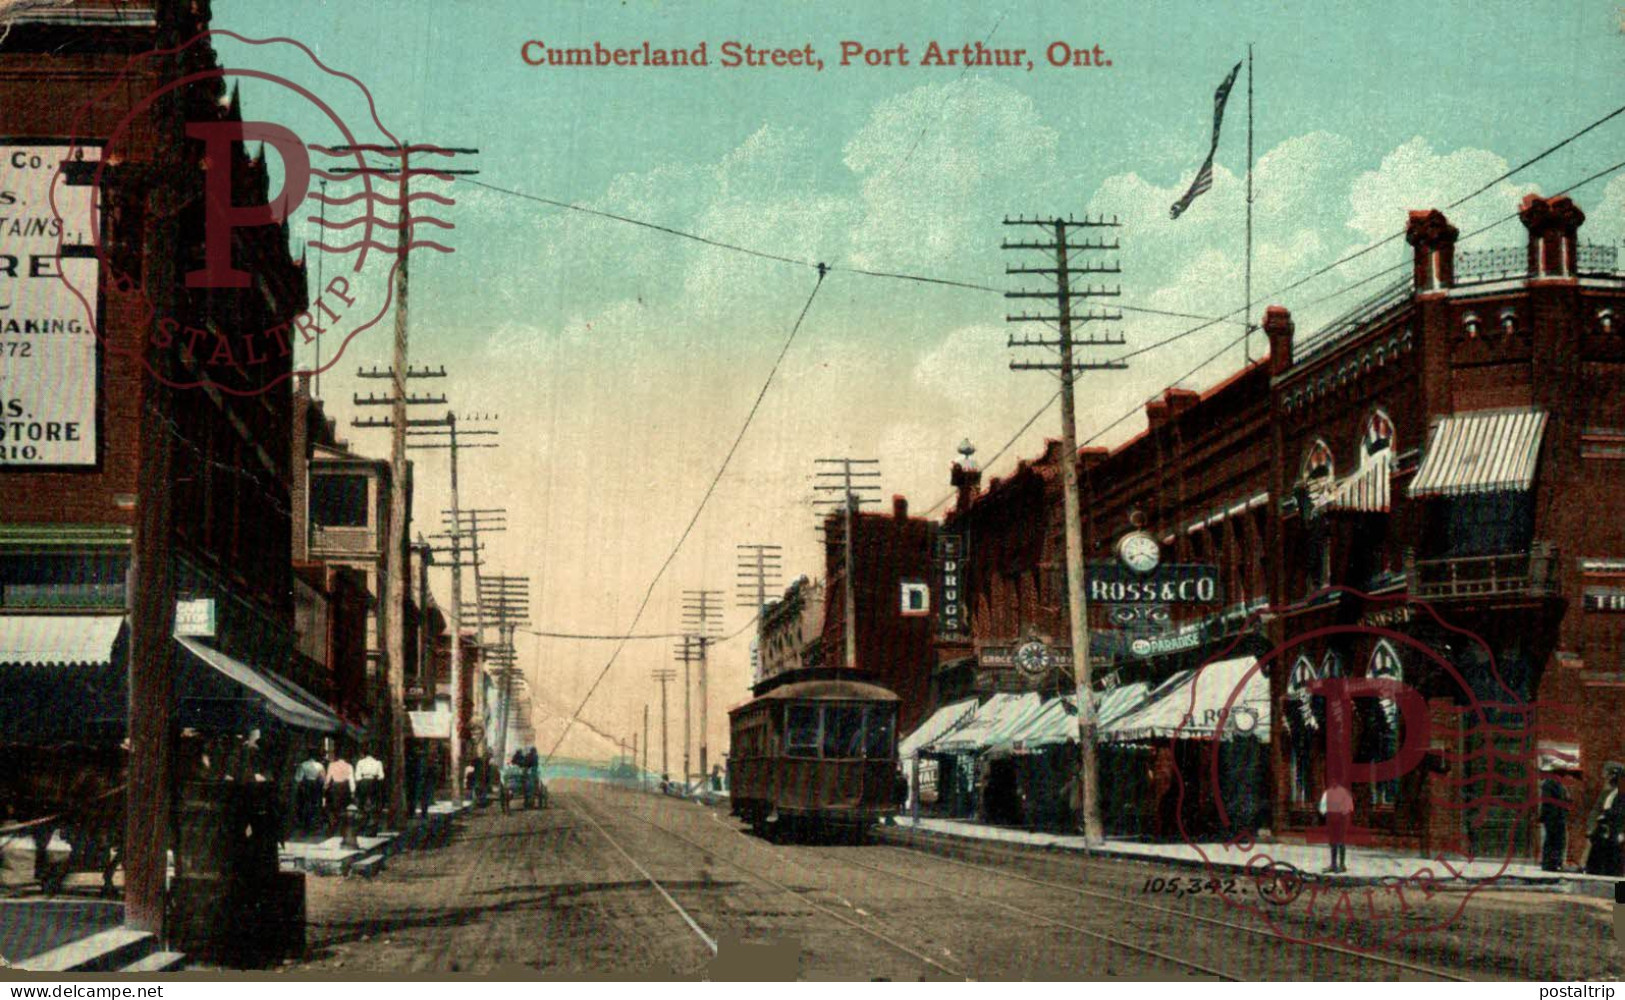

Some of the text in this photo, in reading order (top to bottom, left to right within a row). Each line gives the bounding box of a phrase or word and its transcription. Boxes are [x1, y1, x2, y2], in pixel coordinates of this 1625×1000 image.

[521, 40, 1113, 71] Cumberland Street, Port Arthur, Ont.
[11, 151, 52, 169] Co.
[0, 319, 90, 334] AKING.
[0, 398, 32, 418] S.
[944, 561, 958, 629] DRUGS
[1091, 577, 1214, 601] ROSS&CO
[1151, 633, 1199, 653] PARADISE
